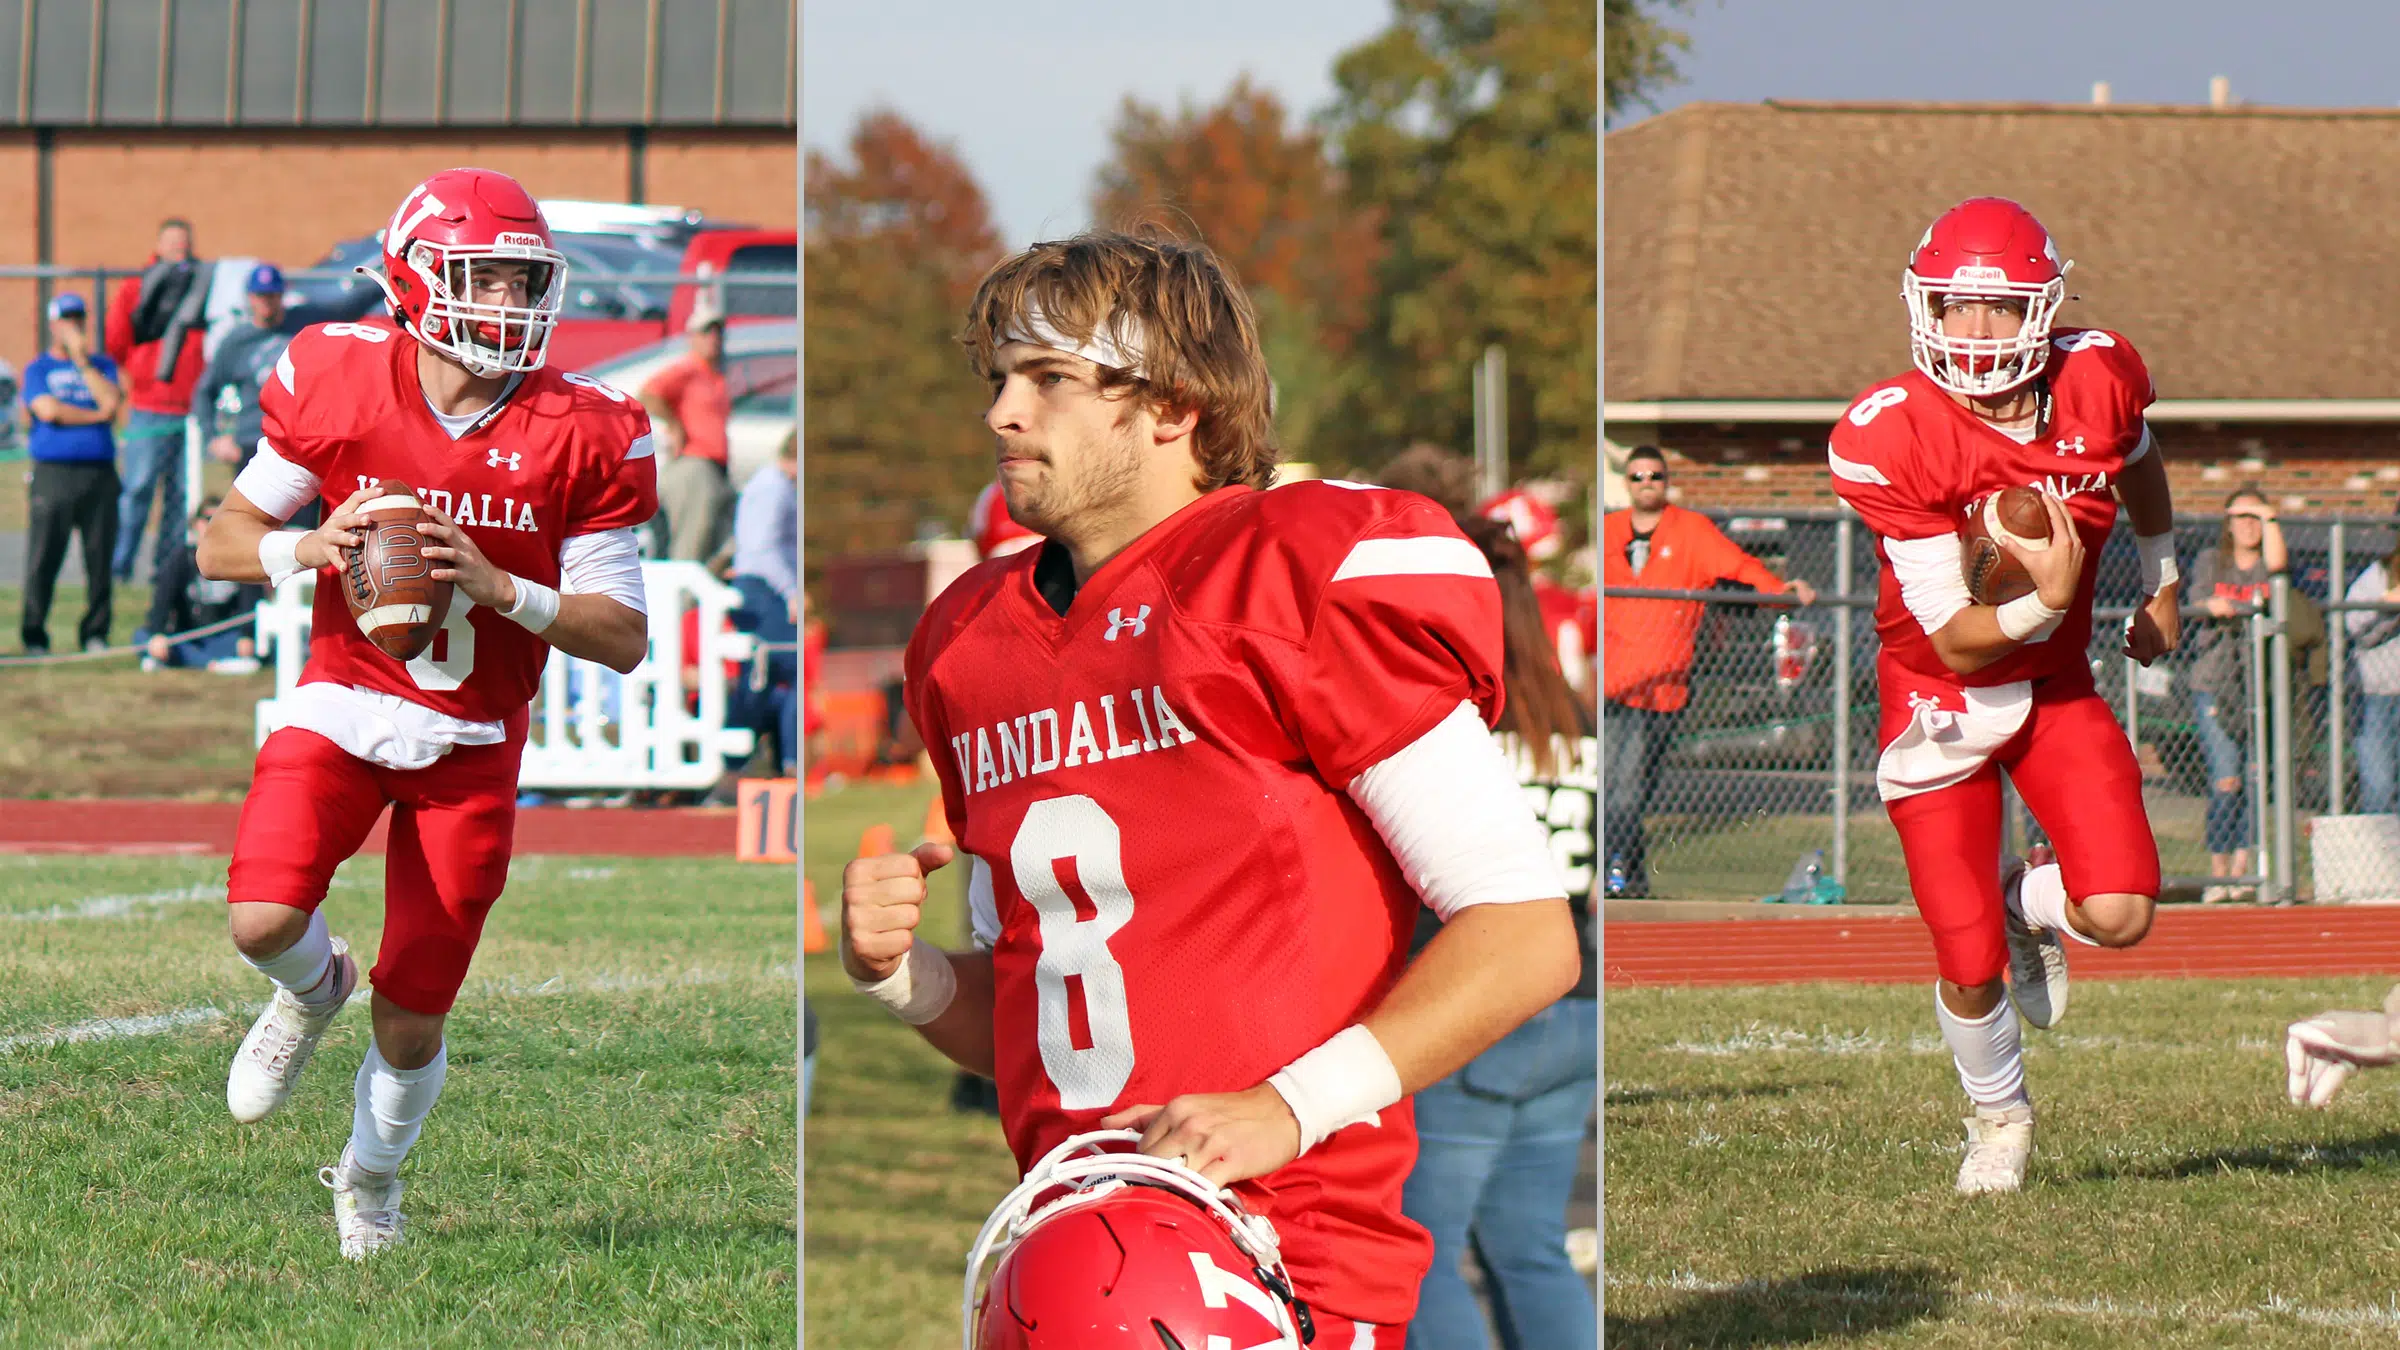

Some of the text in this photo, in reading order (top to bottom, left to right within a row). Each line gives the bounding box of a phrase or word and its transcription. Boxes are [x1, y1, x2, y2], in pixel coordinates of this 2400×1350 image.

[503, 235, 541, 247] Riddell
[321, 322, 390, 343] 8
[2054, 330, 2115, 352] 8
[1849, 386, 1908, 426] 8
[952, 685, 1197, 796] VANDALIA
[1010, 795, 1134, 1111] 8
